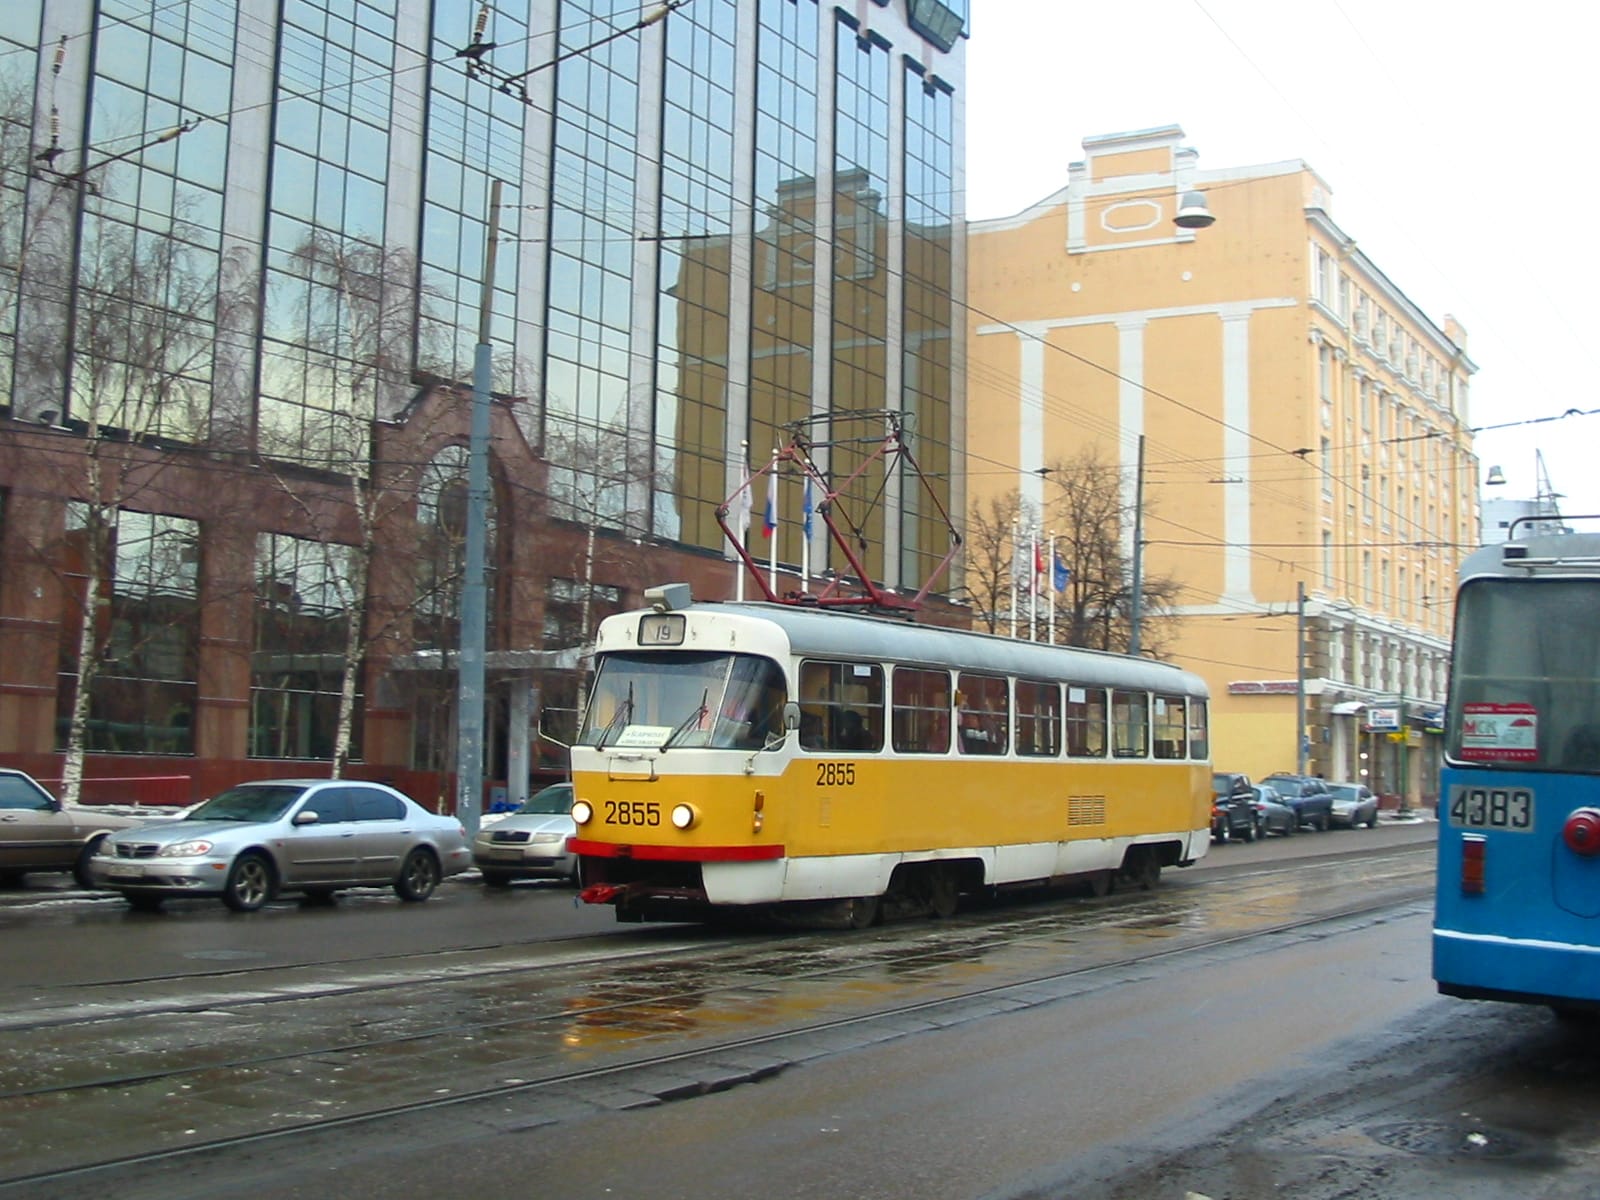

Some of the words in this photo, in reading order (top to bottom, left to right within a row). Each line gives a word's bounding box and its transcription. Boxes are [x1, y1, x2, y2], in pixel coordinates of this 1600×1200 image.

[656, 624, 671, 641] 19
[816, 762, 856, 786] 2855
[604, 800, 661, 827] 2855
[1450, 789, 1531, 828] 4383
